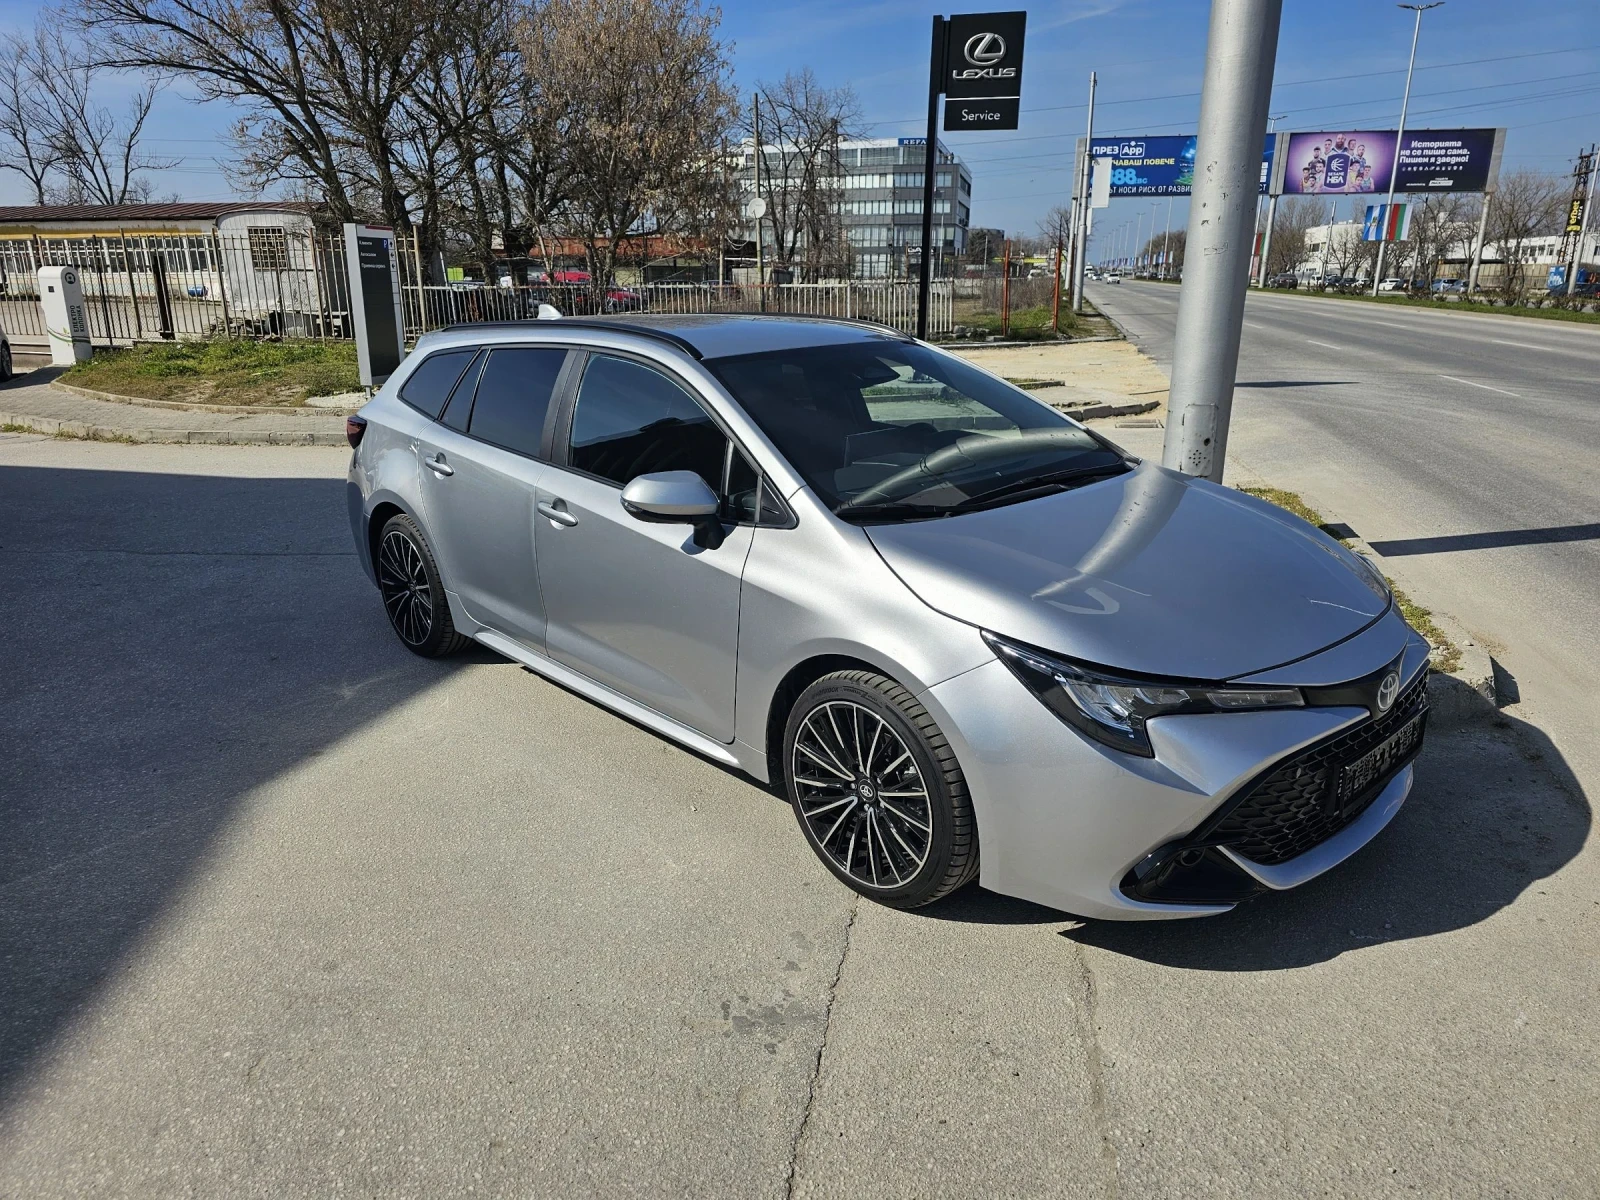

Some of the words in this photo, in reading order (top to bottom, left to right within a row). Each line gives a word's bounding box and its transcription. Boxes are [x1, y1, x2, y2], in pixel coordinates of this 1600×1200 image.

[953, 68, 1017, 79] LEXUS
[961, 109, 1001, 121] Service
[1411, 140, 1462, 149] Историята
[1092, 146, 1119, 155] ПРЕЗ
[1121, 146, 1143, 156] App
[1436, 155, 1469, 164] заедно!
[1118, 186, 1137, 194] НОСИ
[1157, 185, 1167, 193] ОТ
[70, 305, 79, 332] ЕЛЕКТРО
[76, 305, 84, 332] КОЛОНКА
